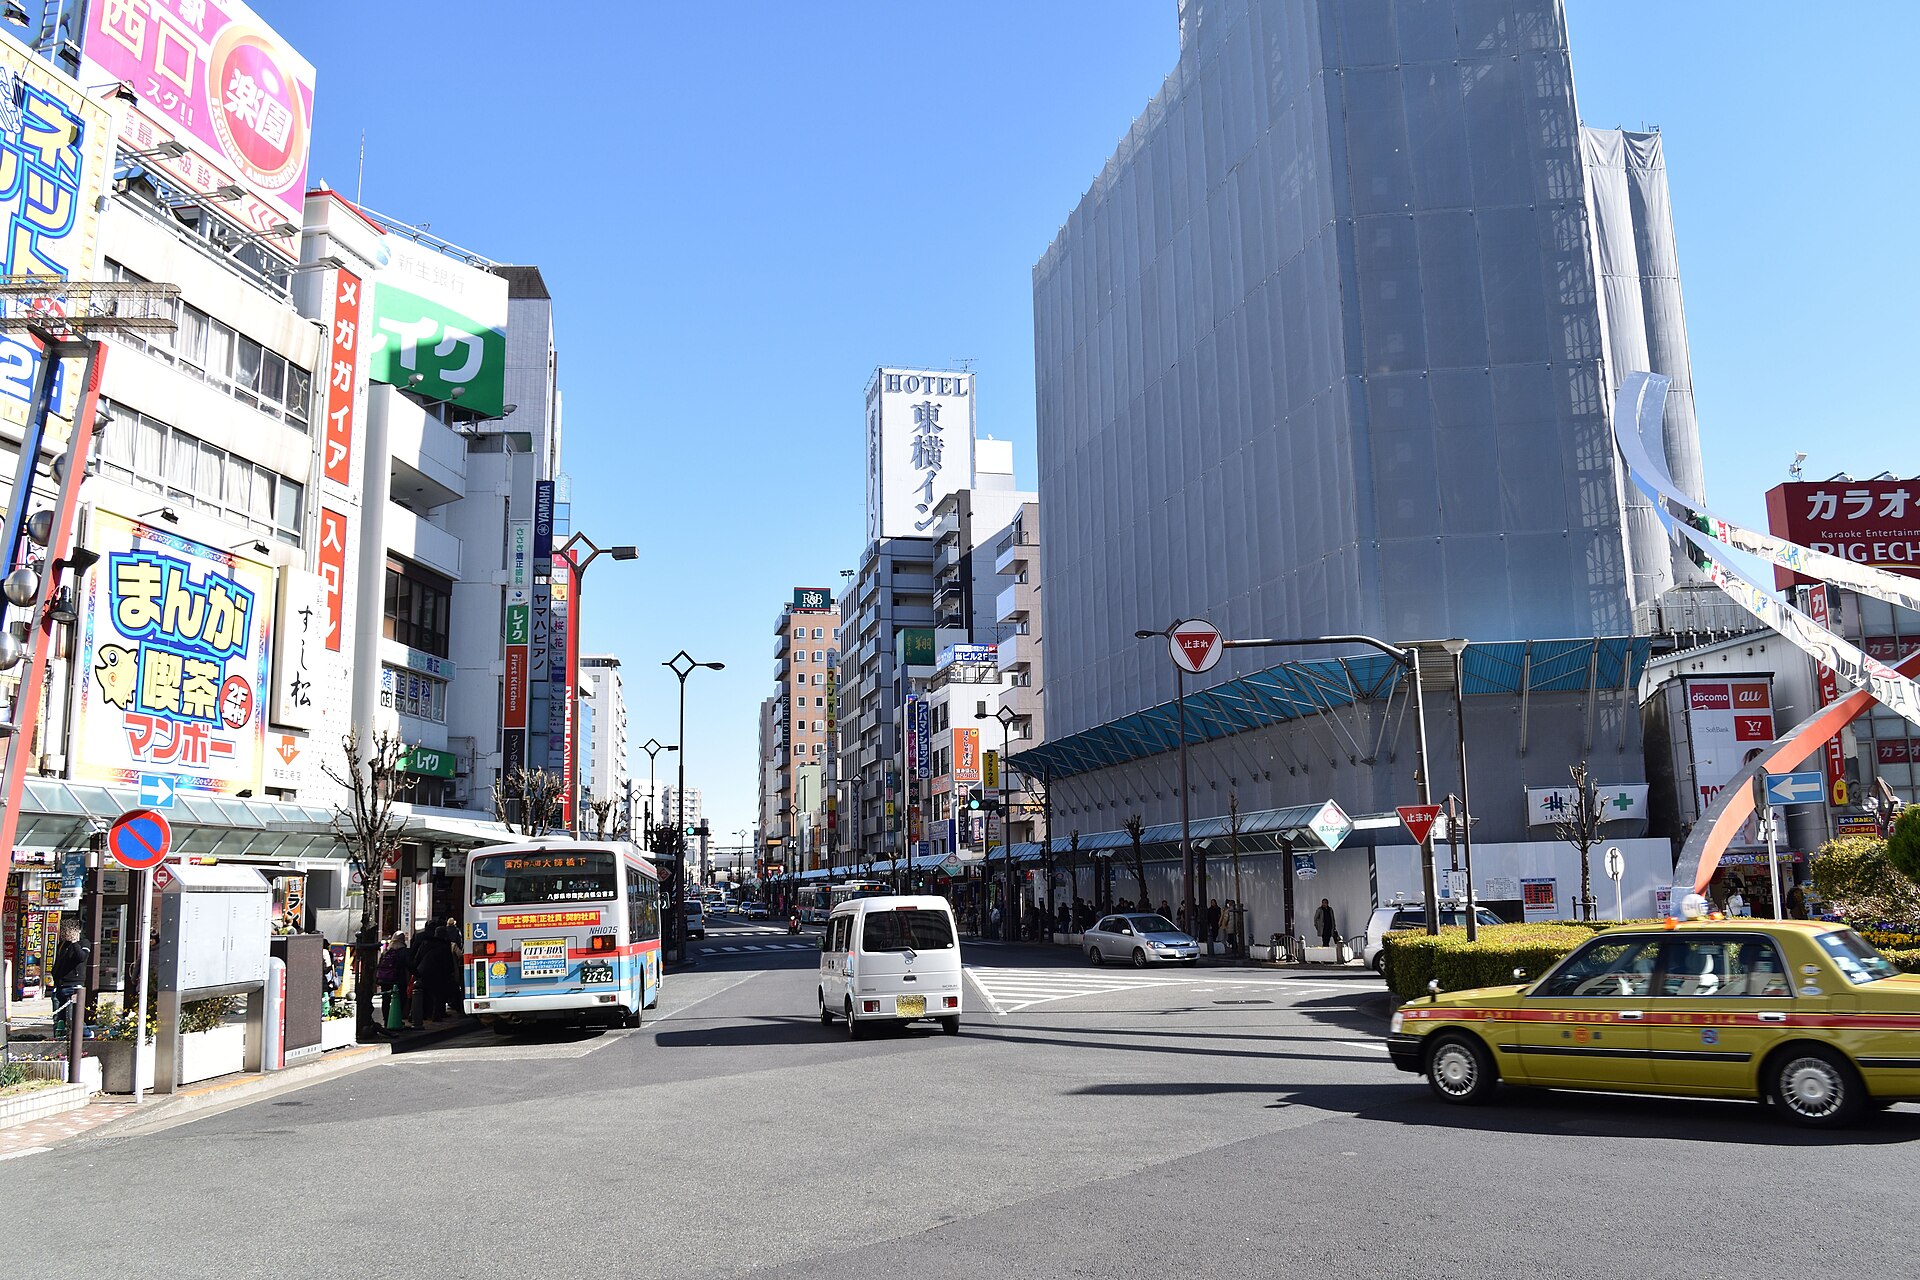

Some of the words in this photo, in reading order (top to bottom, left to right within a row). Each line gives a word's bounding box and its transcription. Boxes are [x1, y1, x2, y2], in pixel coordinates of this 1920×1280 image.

[223, 67, 294, 154] 楽園
[398, 253, 465, 296] 新生銀行
[328, 281, 358, 469] メガガイア
[884, 374, 968, 398] HOTEL
[910, 400, 946, 532] 東横イン
[538, 485, 551, 524] YAMAHA
[1806, 488, 1920, 521] カラオ
[1821, 530, 1861, 539] Karaoke
[319, 517, 343, 596] 入口
[117, 561, 249, 651] まんが
[802, 592, 823, 605] R&B
[511, 610, 523, 641] レイク
[533, 594, 548, 671] ヤマハピアノ
[1183, 638, 1209, 650] 止まれ
[290, 605, 313, 708] すし松
[510, 653, 518, 675] First
[954, 652, 989, 661] 当ビル2F
[144, 647, 221, 719] 喫茶
[228, 683, 249, 703] 2F
[381, 692, 393, 707] 03
[510, 676, 518, 712] Kitchen
[1692, 692, 1728, 702] docomo
[1739, 689, 1763, 702] au
[918, 704, 929, 766] アパマンショップ
[1745, 720, 1762, 732] Y!
[125, 715, 236, 767] マンボー
[282, 744, 294, 757] 1F
[416, 751, 440, 772] レイク
[1406, 813, 1433, 823] 止まれ
[542, 857, 587, 868] 大師橋下
[589, 926, 619, 935] NH1075
[523, 946, 565, 956] CITY-BOX
[1476, 1010, 1512, 1020] TAXI
[1552, 1012, 1613, 1023] TEITO
